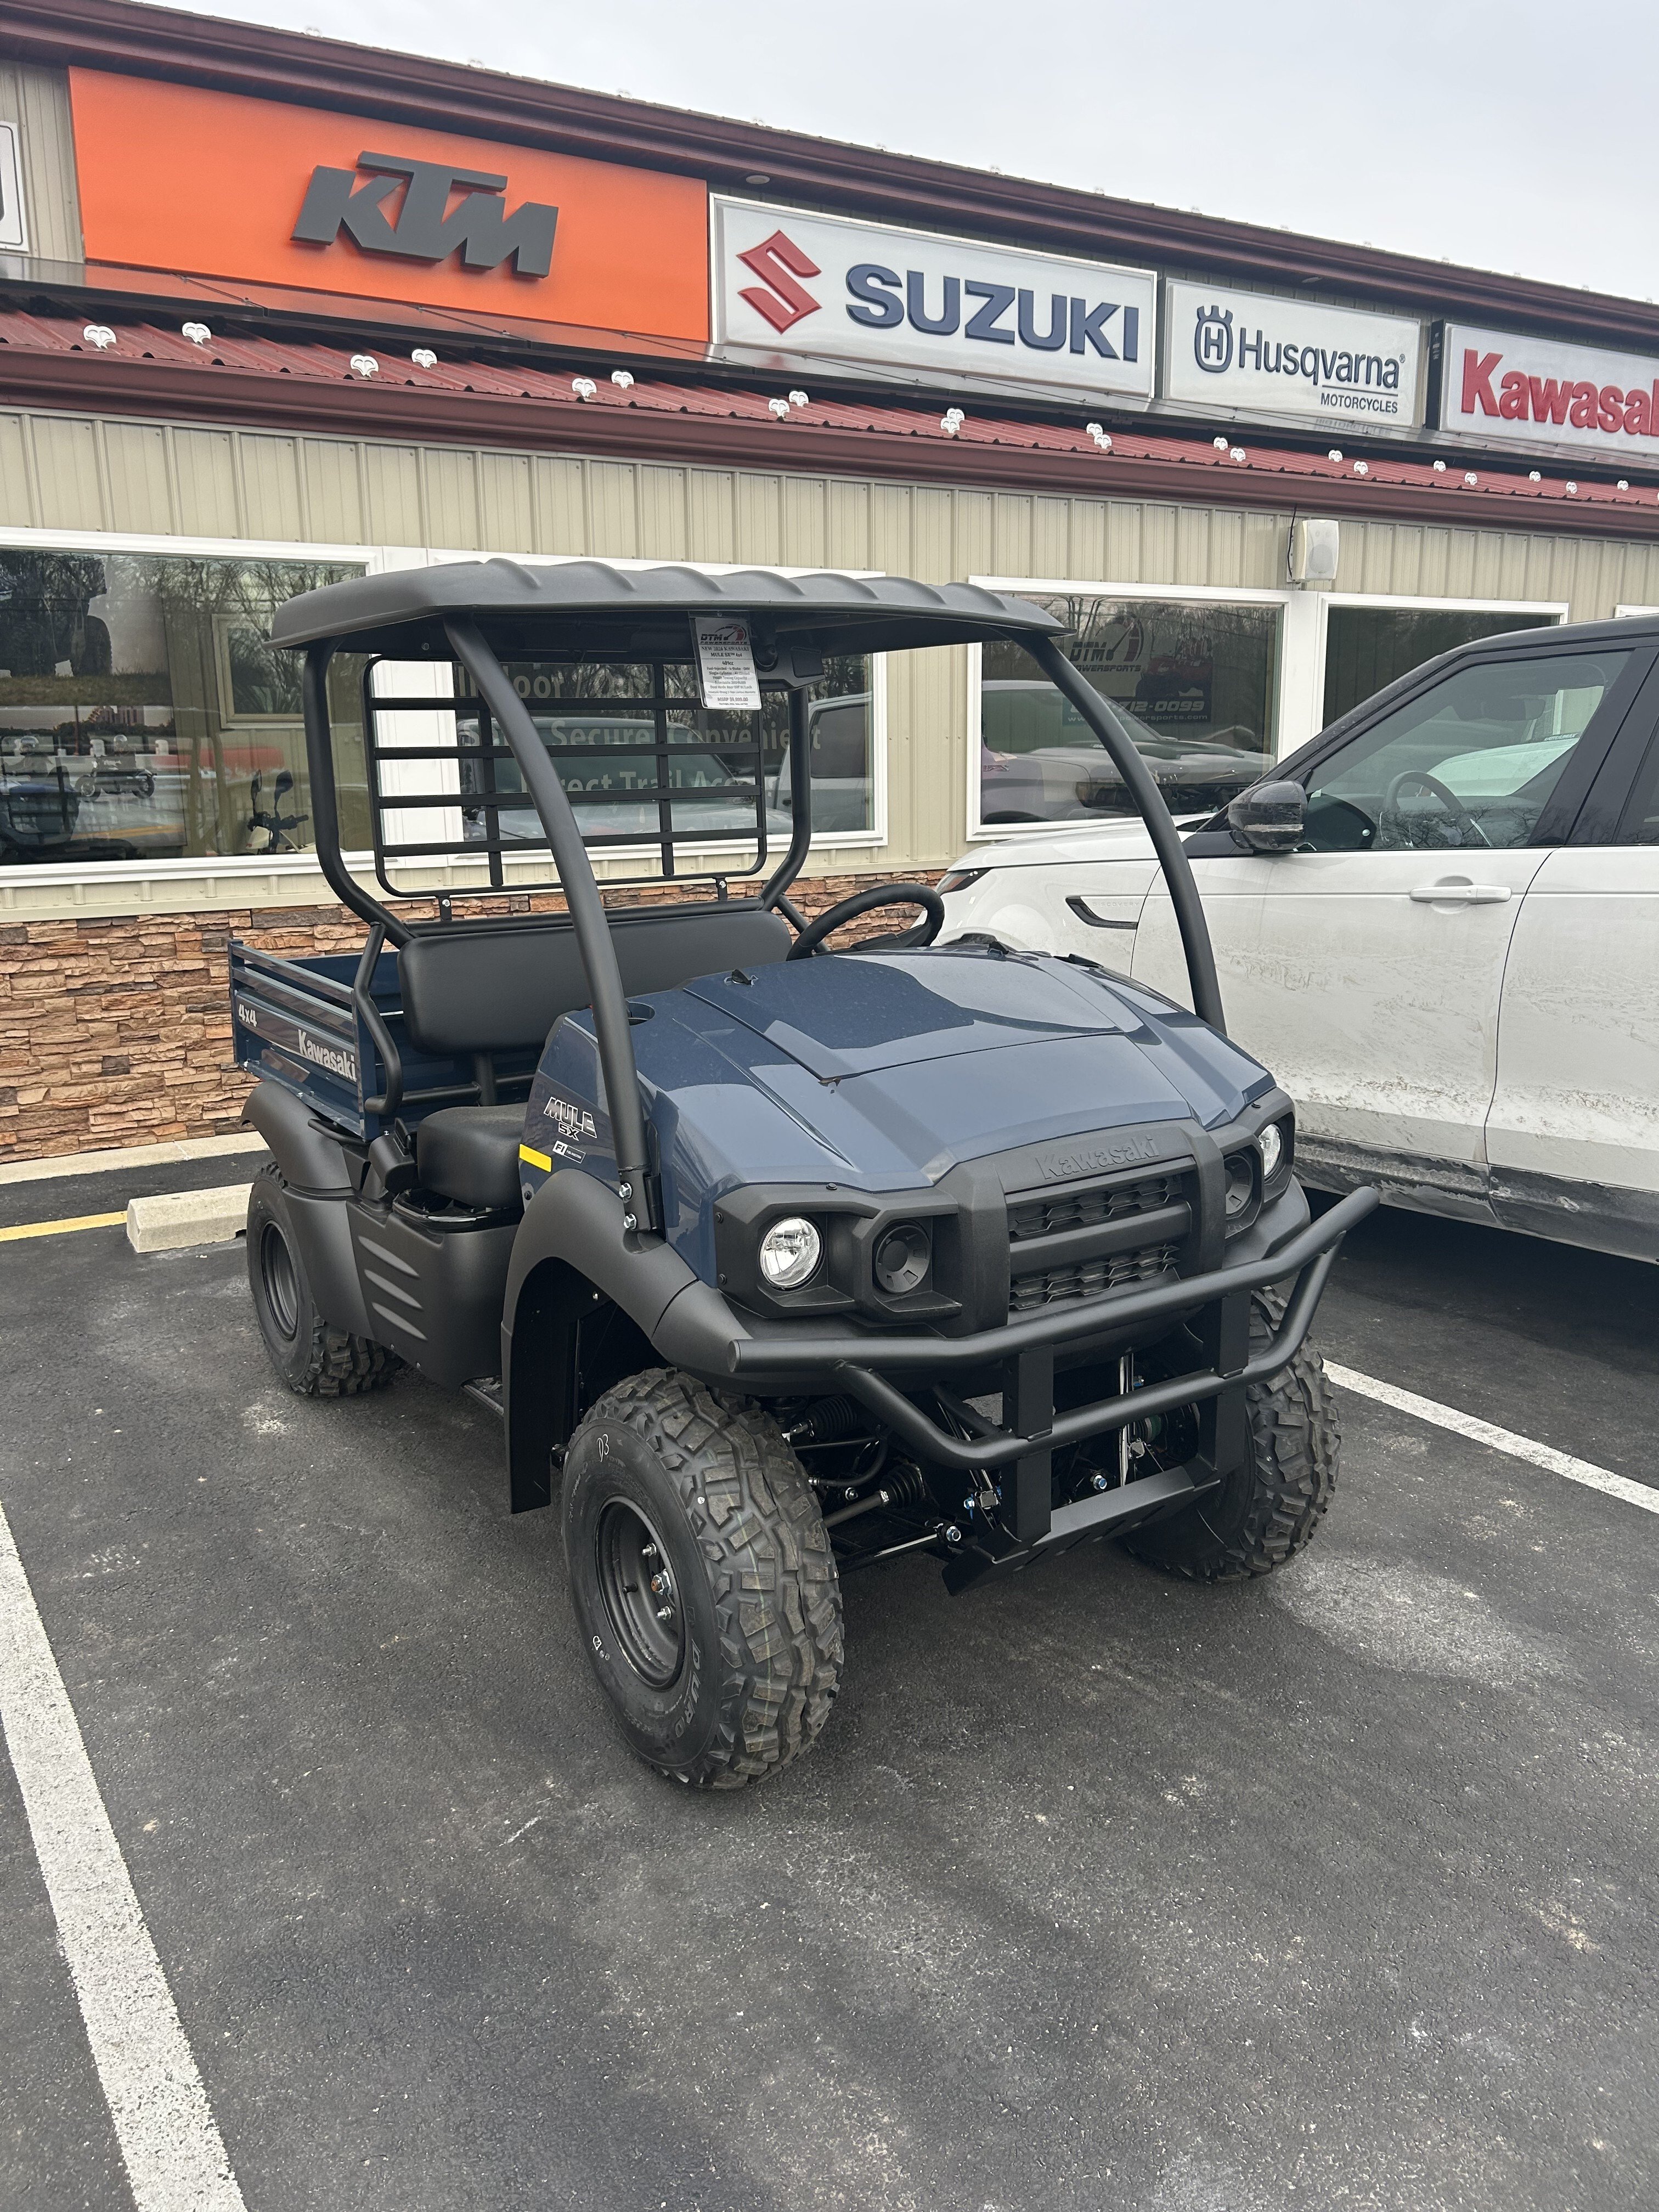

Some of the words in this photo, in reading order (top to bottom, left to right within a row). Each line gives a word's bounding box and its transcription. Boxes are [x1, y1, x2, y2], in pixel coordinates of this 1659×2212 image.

[290, 150, 558, 279] KTM
[845, 263, 1139, 363] SUZUKI
[1321, 393, 1398, 414] MOTORCYCLES
[1461, 348, 1659, 437] Kawasa
[1069, 641, 1107, 662] DTM
[1075, 664, 1142, 672] OWERSPORTS
[551, 720, 651, 746] Secure
[238, 1003, 257, 1028] 4x4
[298, 1029, 357, 1082] Kawasaki
[544, 1096, 597, 1139] MULE
[558, 1121, 580, 1142] SX
[555, 1143, 566, 1153] FI
[1035, 1133, 1161, 1180] Kawasaki
